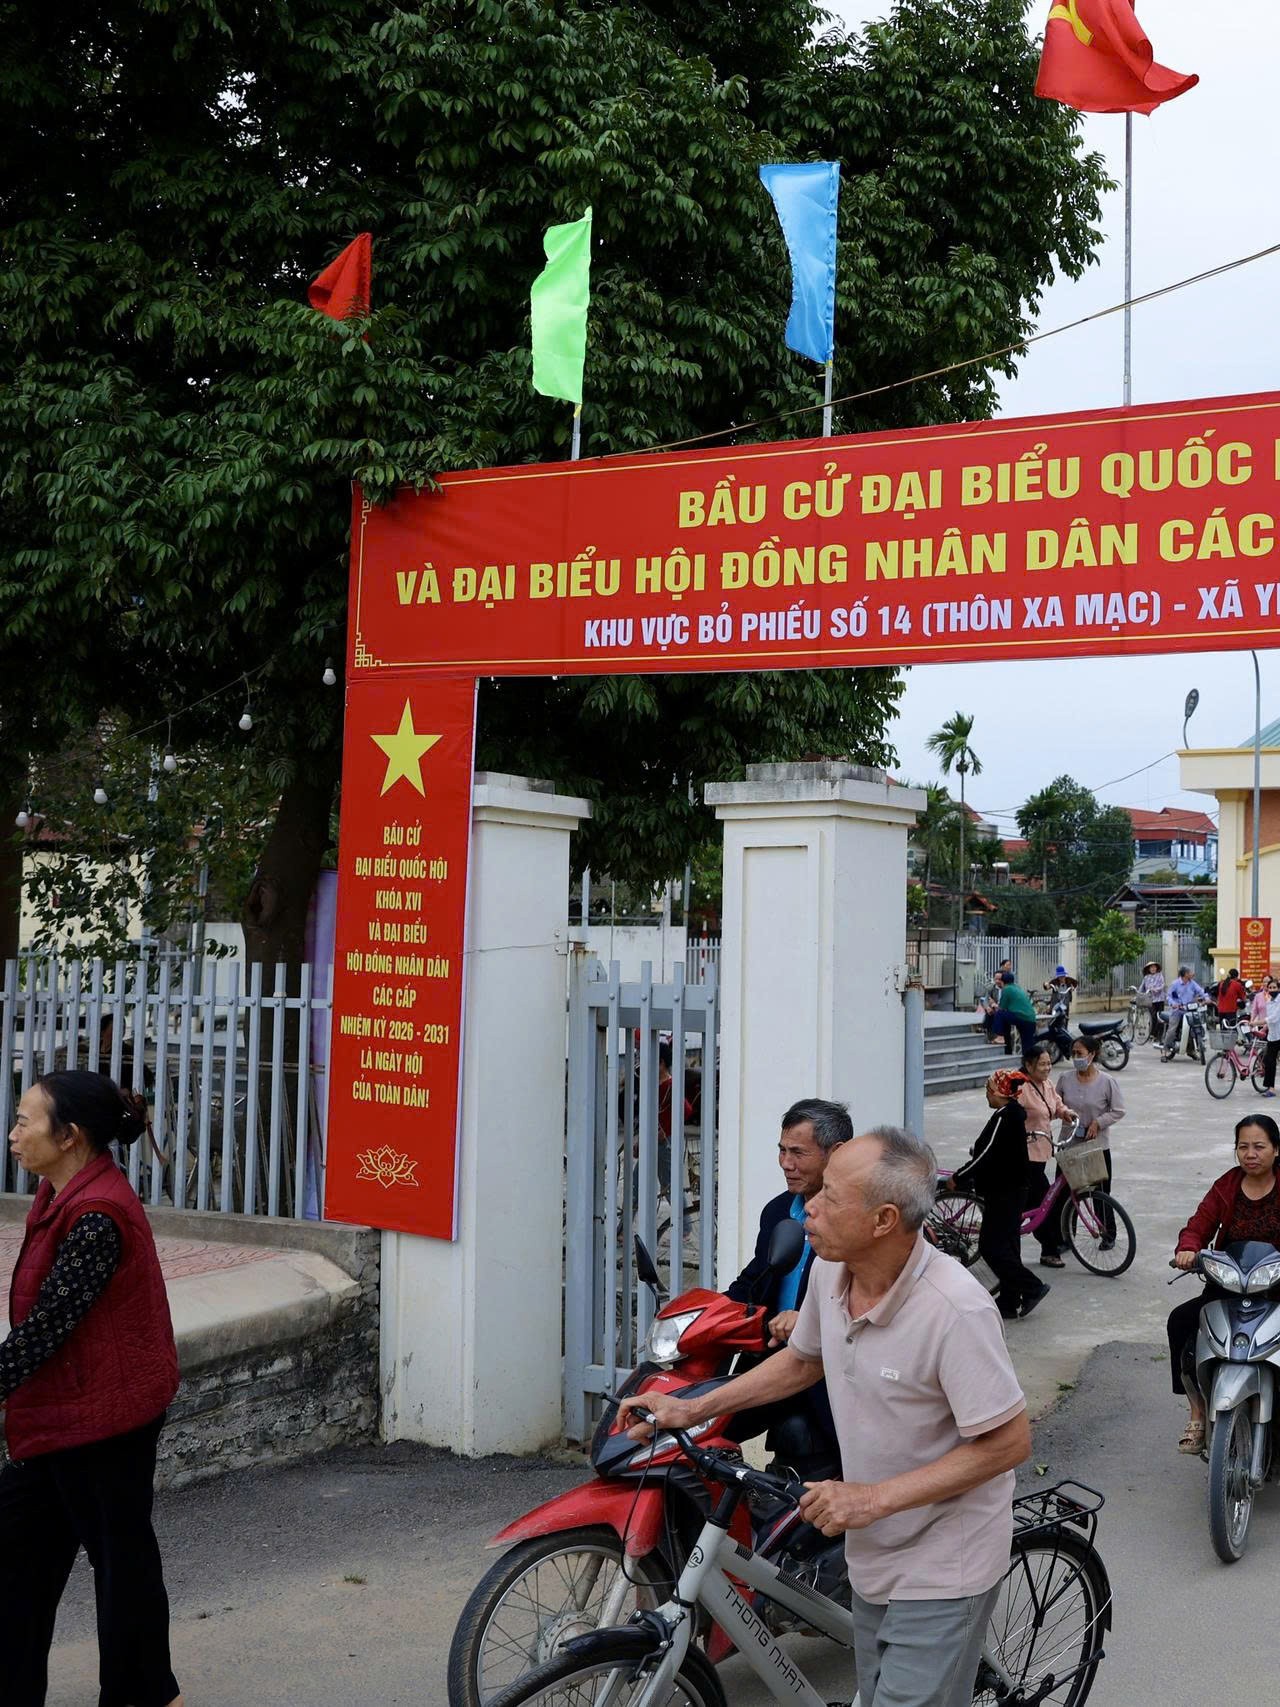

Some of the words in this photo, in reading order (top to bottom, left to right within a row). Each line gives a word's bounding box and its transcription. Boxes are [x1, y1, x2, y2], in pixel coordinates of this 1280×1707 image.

[679, 475, 766, 528] BẦU
[784, 462, 851, 520] CỬ
[860, 470, 942, 519] ĐẠI
[962, 443, 1080, 506] BIỂU
[1101, 429, 1252, 498] QUỐC
[397, 563, 440, 604] VÀ
[453, 565, 515, 608] ĐẠI
[530, 546, 620, 598] BIỂU
[636, 547, 705, 600] HỘI
[720, 536, 847, 589] ĐỒNG
[866, 528, 1006, 580] NHÂN
[1027, 518, 1137, 570] DÂN
[1160, 507, 1274, 562] CÁC
[585, 619, 633, 647] KHU
[641, 614, 689, 650] VỰC
[699, 602, 732, 643] BỎ
[742, 598, 822, 643] PHIẾU
[831, 596, 869, 637] SỐ
[878, 606, 911, 635] 14
[923, 594, 1011, 636] (THÔN
[1022, 596, 1064, 628] XA
[1076, 591, 1160, 631] MẠC)
[1197, 579, 1243, 619] XÃ
[384, 820, 404, 846] BẦU
[406, 819, 423, 847] CỬ
[356, 857, 372, 881] ĐẠI
[374, 851, 398, 878] BIỂU
[399, 853, 427, 881] QUỐC
[429, 857, 448, 885] HỘI
[376, 887, 403, 911] KHÓA
[405, 892, 422, 912] XVI
[369, 918, 382, 942] VÀ
[384, 923, 401, 947] ĐẠI
[404, 917, 428, 945] BIỂU
[347, 949, 364, 976] HỘI
[365, 948, 393, 975] ĐỒNG
[395, 953, 425, 977] NHÂN
[427, 955, 450, 979] DÂN
[373, 983, 394, 1007] CÁC
[396, 982, 417, 1009] CẤP
[341, 1013, 372, 1040] NHIỆM
[374, 1016, 388, 1039] KỲ
[389, 1020, 414, 1042] 2026
[424, 1024, 450, 1045] 2031
[361, 1046, 373, 1070] LÀ
[375, 1049, 403, 1073] NGÀY
[405, 1051, 424, 1079] HỘI
[353, 1074, 372, 1102] CỦA
[375, 1081, 401, 1105] TOÀN
[403, 1084, 430, 1109] DÂN!
[725, 1585, 770, 1647] THONG
[769, 1646, 806, 1694] NHAT
